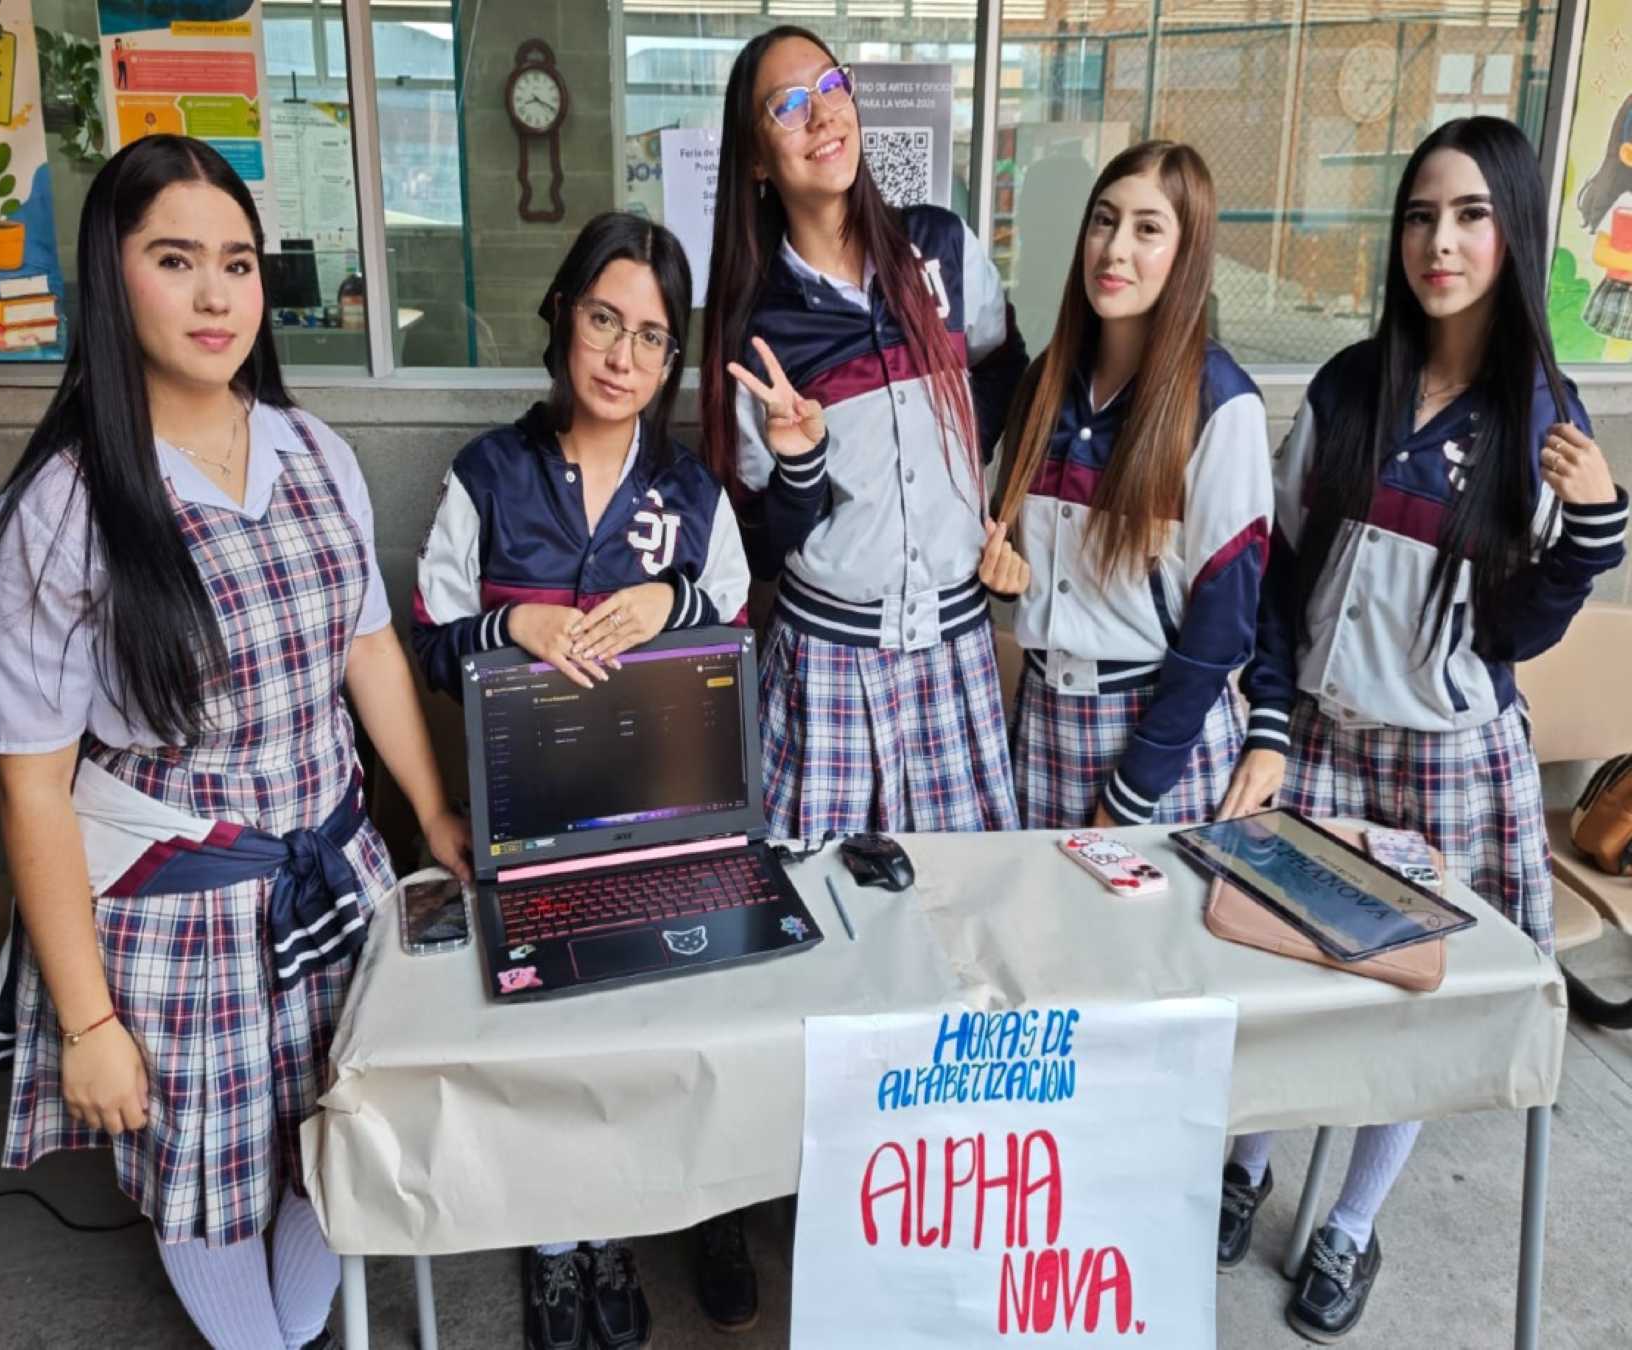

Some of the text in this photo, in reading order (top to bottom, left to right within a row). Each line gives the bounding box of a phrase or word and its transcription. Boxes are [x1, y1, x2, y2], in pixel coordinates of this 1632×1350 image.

[888, 82, 914, 92] ARTES
[894, 99, 915, 108] VIDA
[933, 1008, 1080, 1063] HORAS DE
[861, 1129, 1063, 1250] ALPHA
